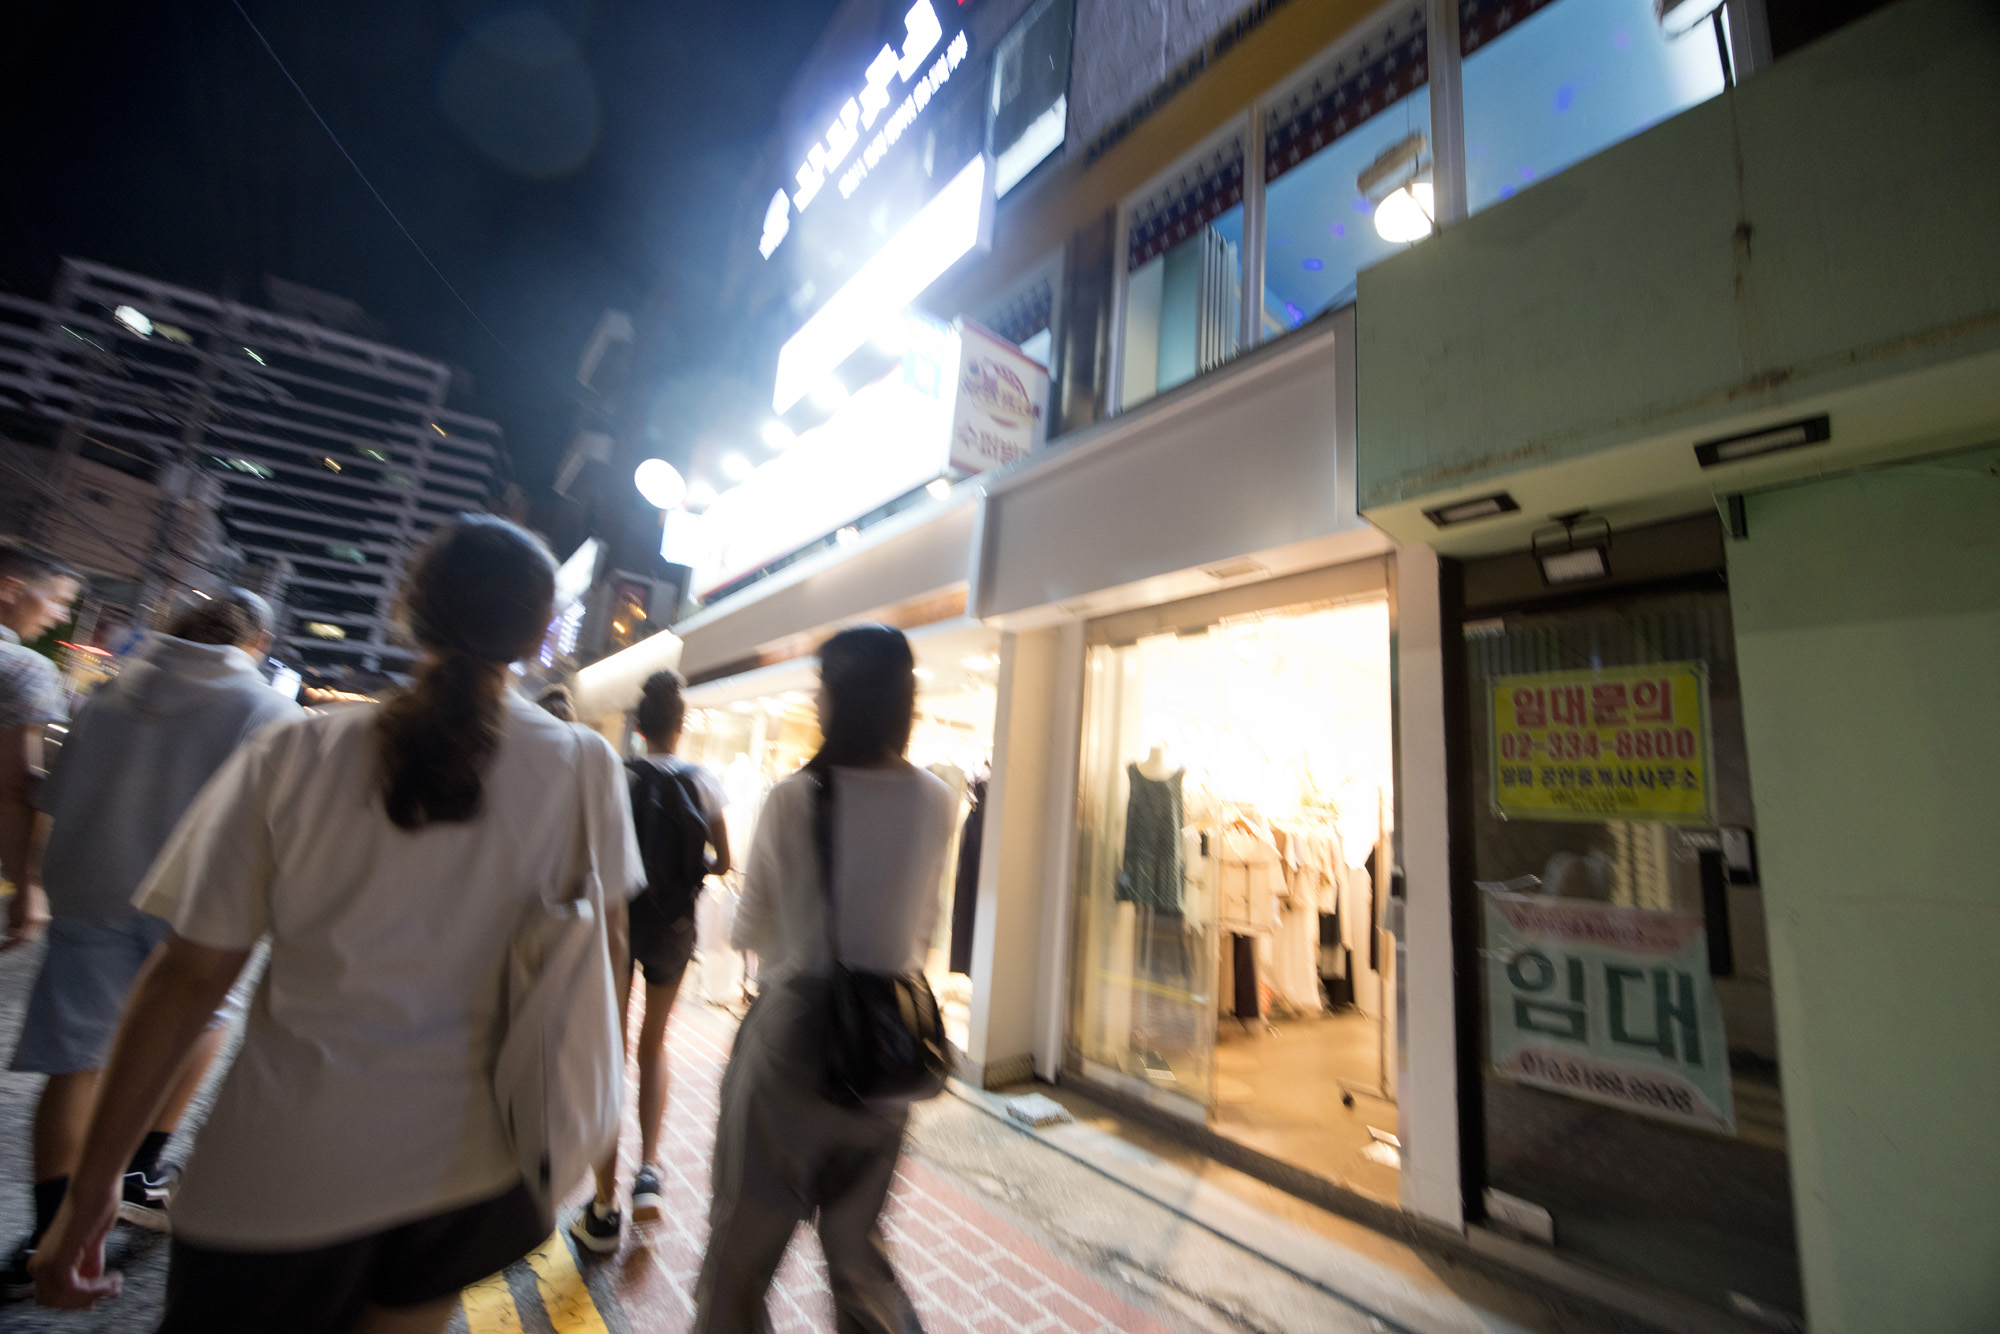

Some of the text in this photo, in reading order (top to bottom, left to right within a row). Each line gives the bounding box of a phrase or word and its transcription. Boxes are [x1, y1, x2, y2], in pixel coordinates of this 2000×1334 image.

[1512, 679, 1673, 728] 임대문의
[1501, 728, 1696, 760] 02-334-8800
[1507, 949, 1704, 1066] 임대
